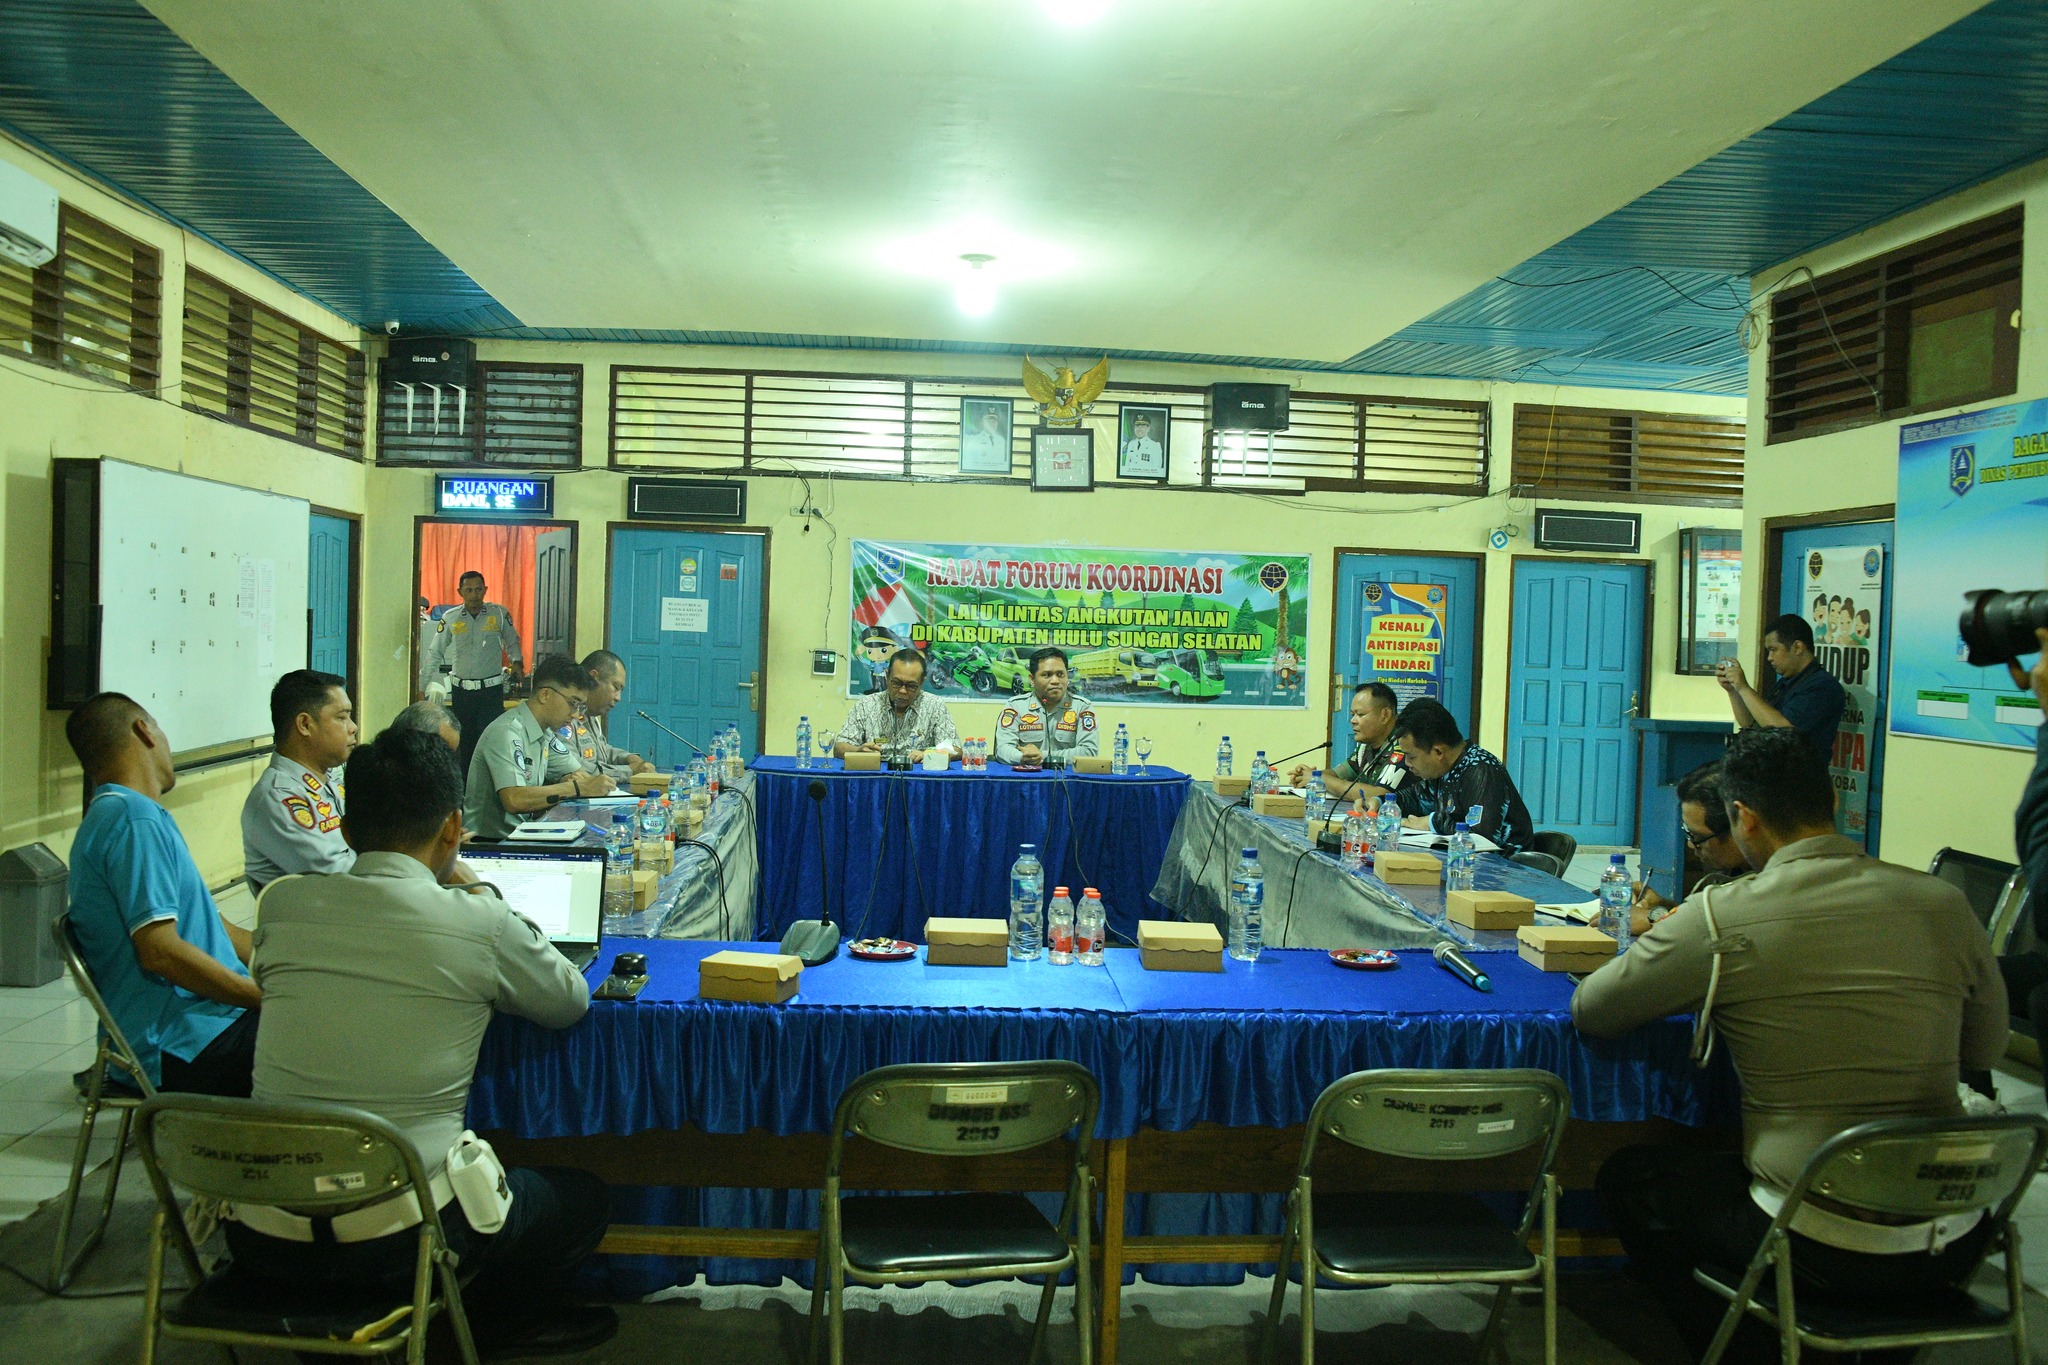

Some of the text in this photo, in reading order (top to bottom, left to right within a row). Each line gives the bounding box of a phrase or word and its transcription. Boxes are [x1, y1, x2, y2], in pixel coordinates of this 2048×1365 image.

[453, 482, 534, 495] RUANGAN
[495, 495, 515, 507] SE
[926, 559, 1223, 595] RAPAT FORUM KOORDINASI
[948, 604, 1229, 628] LALU LINTAS ANGKUTAN JALAN
[1380, 621, 1424, 632] KENALI
[912, 625, 1262, 650] DI KABUPATEN HULU SUNGAI SELATAN
[1367, 640, 1438, 652] ANTISIPASI
[1376, 659, 1431, 670] HINDARI
[956, 1126, 1001, 1140] 2013
